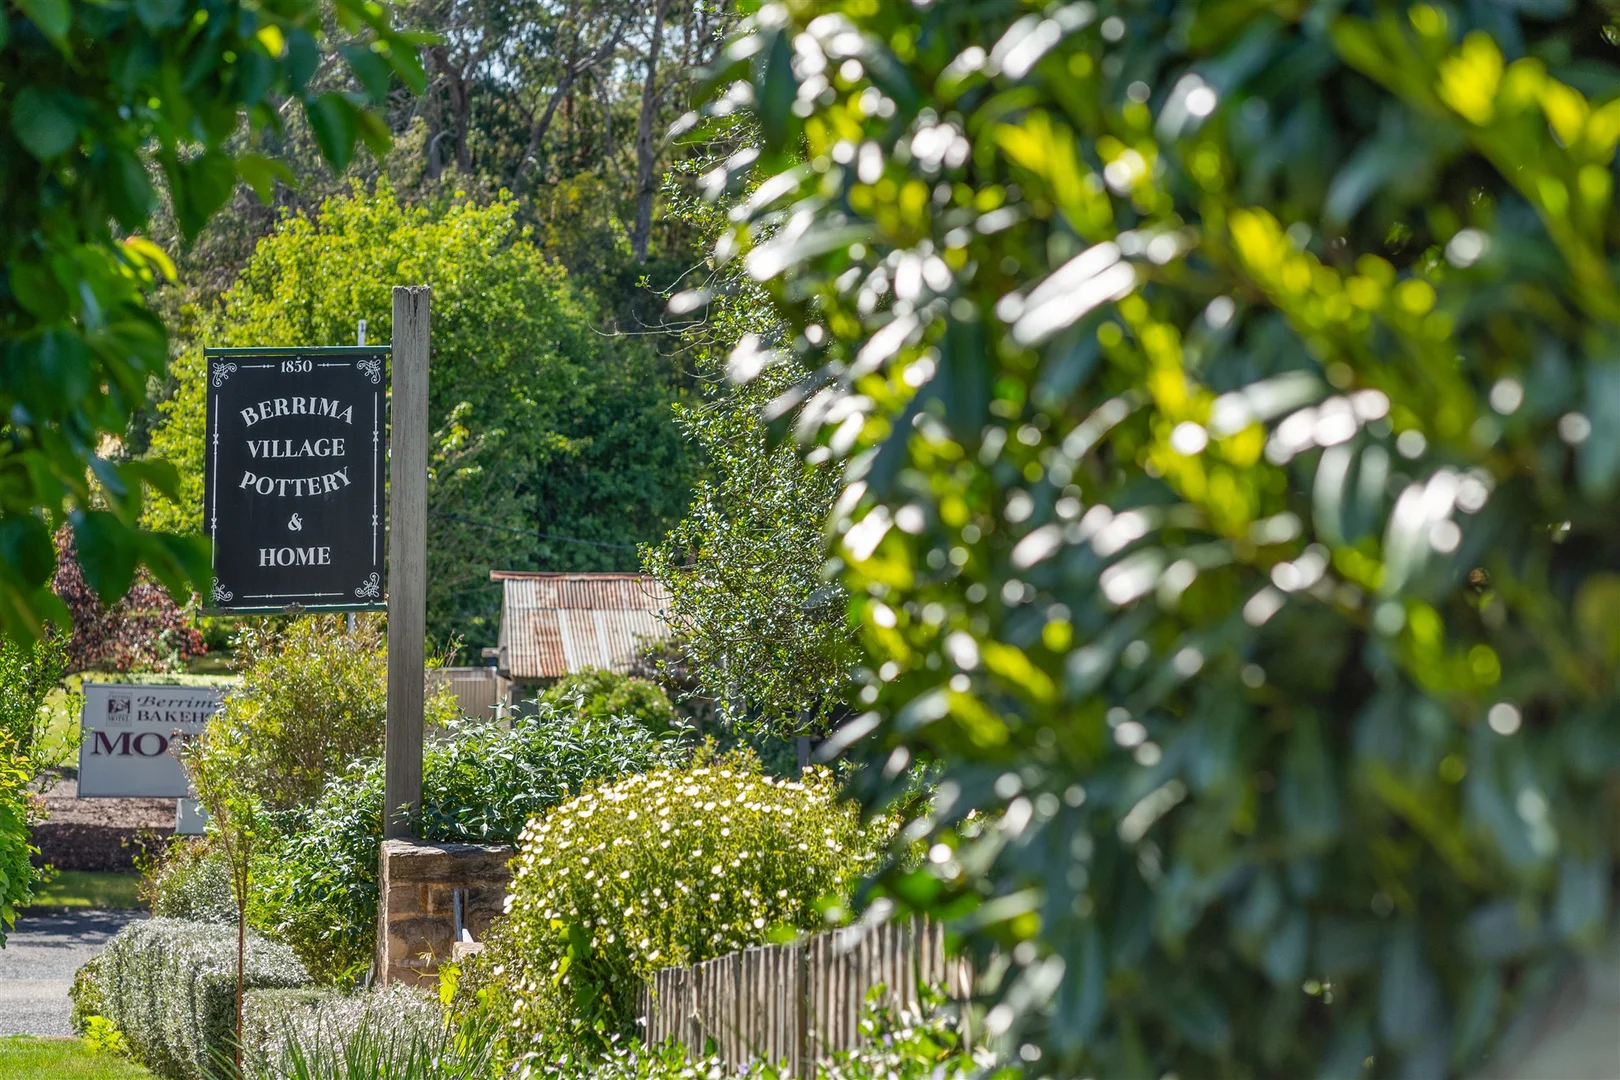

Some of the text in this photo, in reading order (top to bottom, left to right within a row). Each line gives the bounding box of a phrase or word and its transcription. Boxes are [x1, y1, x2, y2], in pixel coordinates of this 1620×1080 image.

[281, 360, 313, 373] 1850
[240, 397, 353, 427] BERRIMA
[247, 438, 346, 458] VILLAGE
[239, 466, 351, 497] POTTERY
[288, 513, 303, 531] &
[259, 547, 331, 567] HOME
